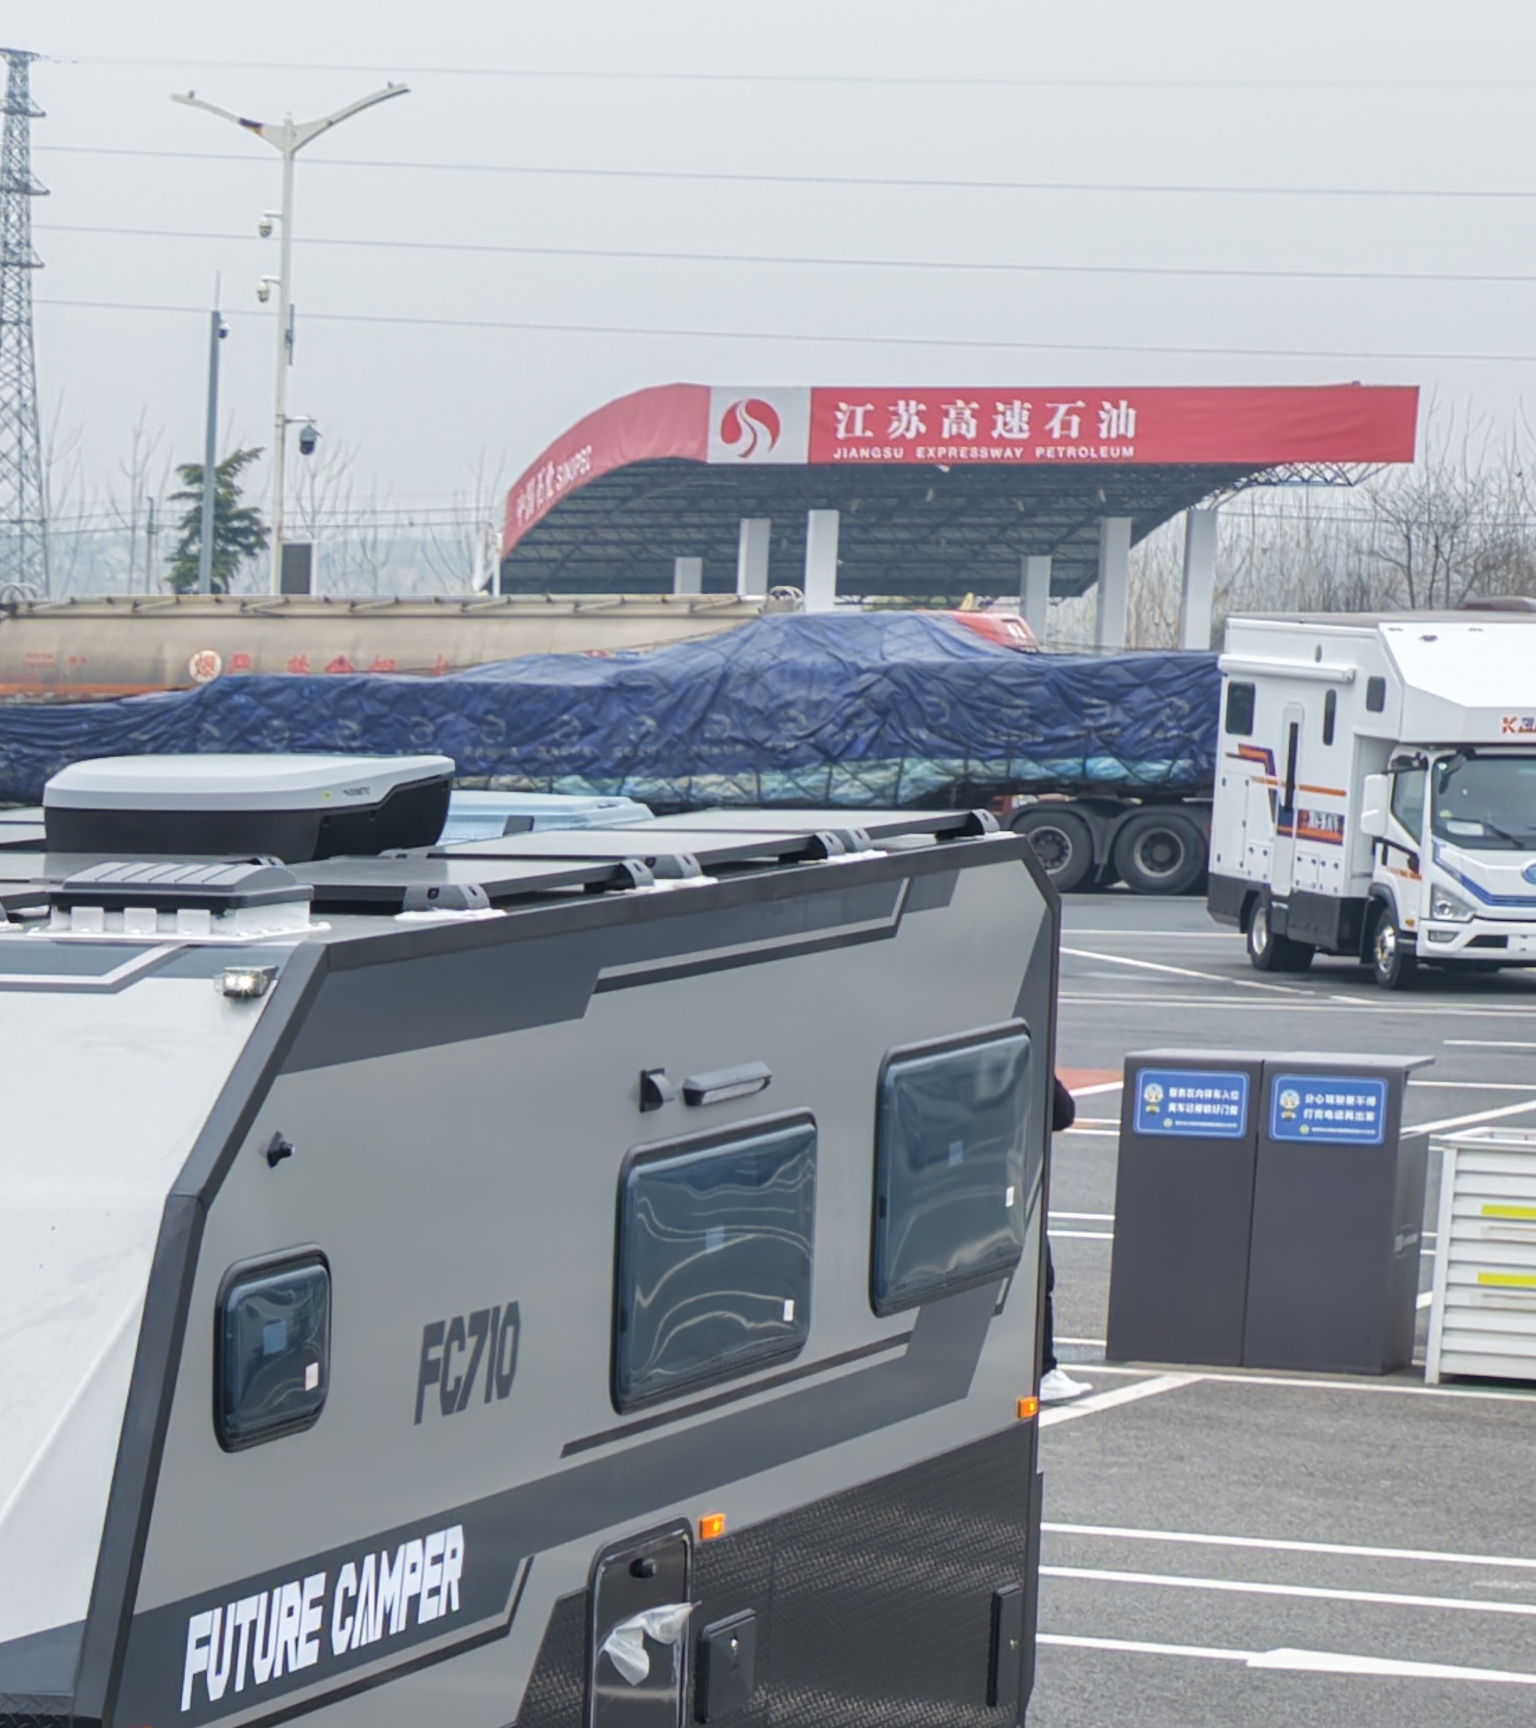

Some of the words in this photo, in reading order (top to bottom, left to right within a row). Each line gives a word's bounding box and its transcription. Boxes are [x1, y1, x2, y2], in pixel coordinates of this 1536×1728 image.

[833, 447, 904, 459] JIANGSU
[916, 446, 1023, 459] EXPRESSWAY
[1035, 446, 1134, 458] PETROLEUM
[834, 399, 1137, 439] 江苏高速石油
[414, 1301, 521, 1425] FC710
[181, 1572, 326, 1713] FUTURE
[331, 1524, 465, 1657] CAMPER
